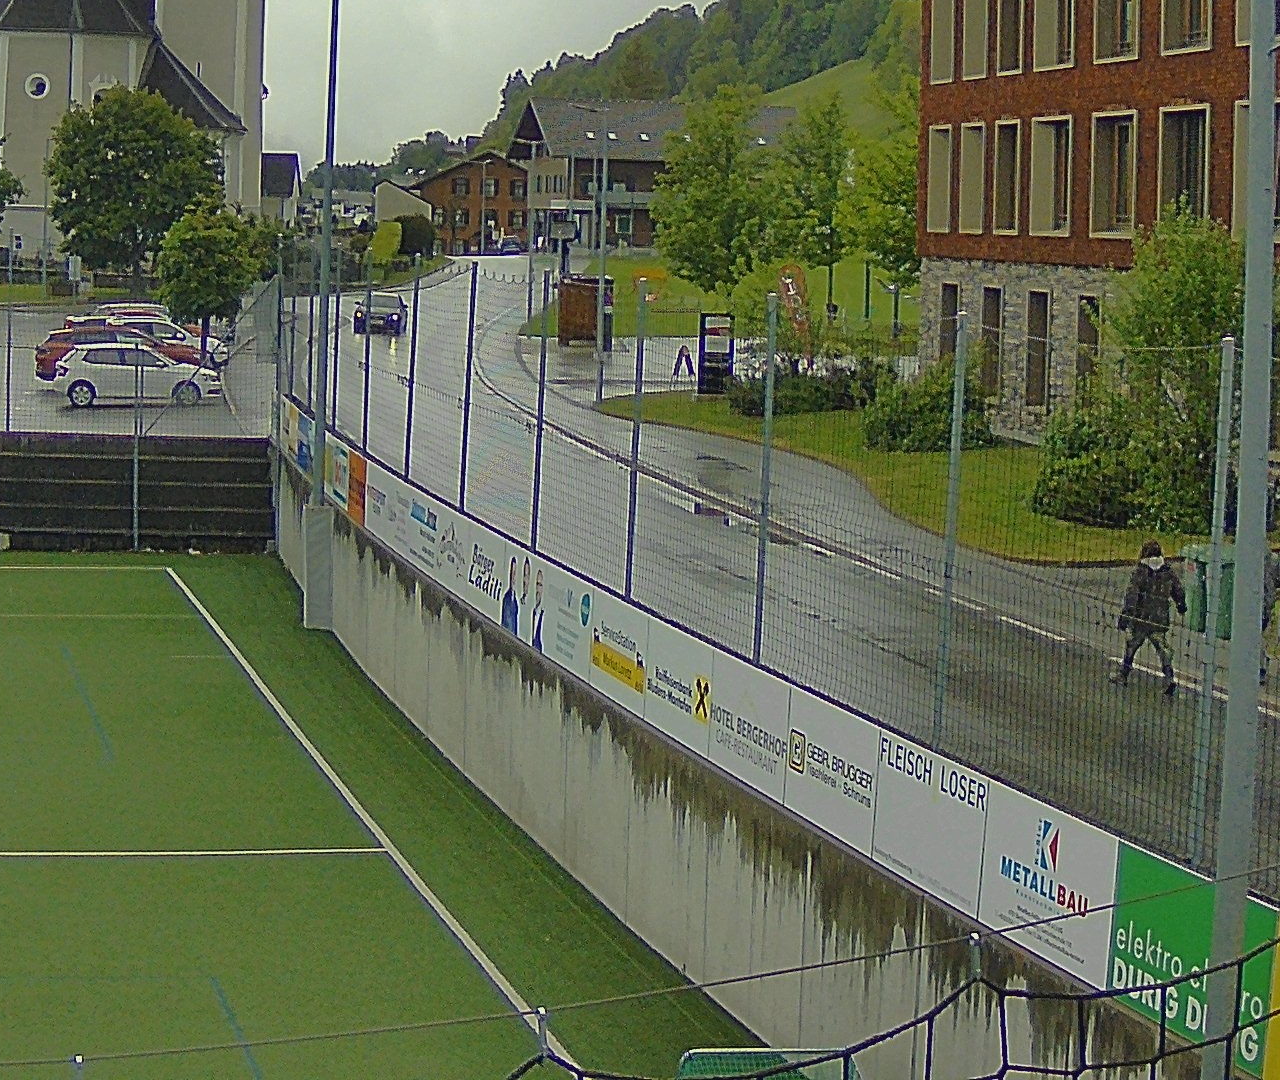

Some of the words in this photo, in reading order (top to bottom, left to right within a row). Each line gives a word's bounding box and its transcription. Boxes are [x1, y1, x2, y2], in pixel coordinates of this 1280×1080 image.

[710, 702, 735, 732] HOTEL
[736, 717, 788, 759] BERGERHOF
[831, 755, 873, 792] BRUGGER
[880, 736, 933, 786] FLEISCH
[940, 764, 987, 812] LOSER
[1000, 855, 1089, 917] METALLBAU
[1116, 920, 1183, 978] elektro
